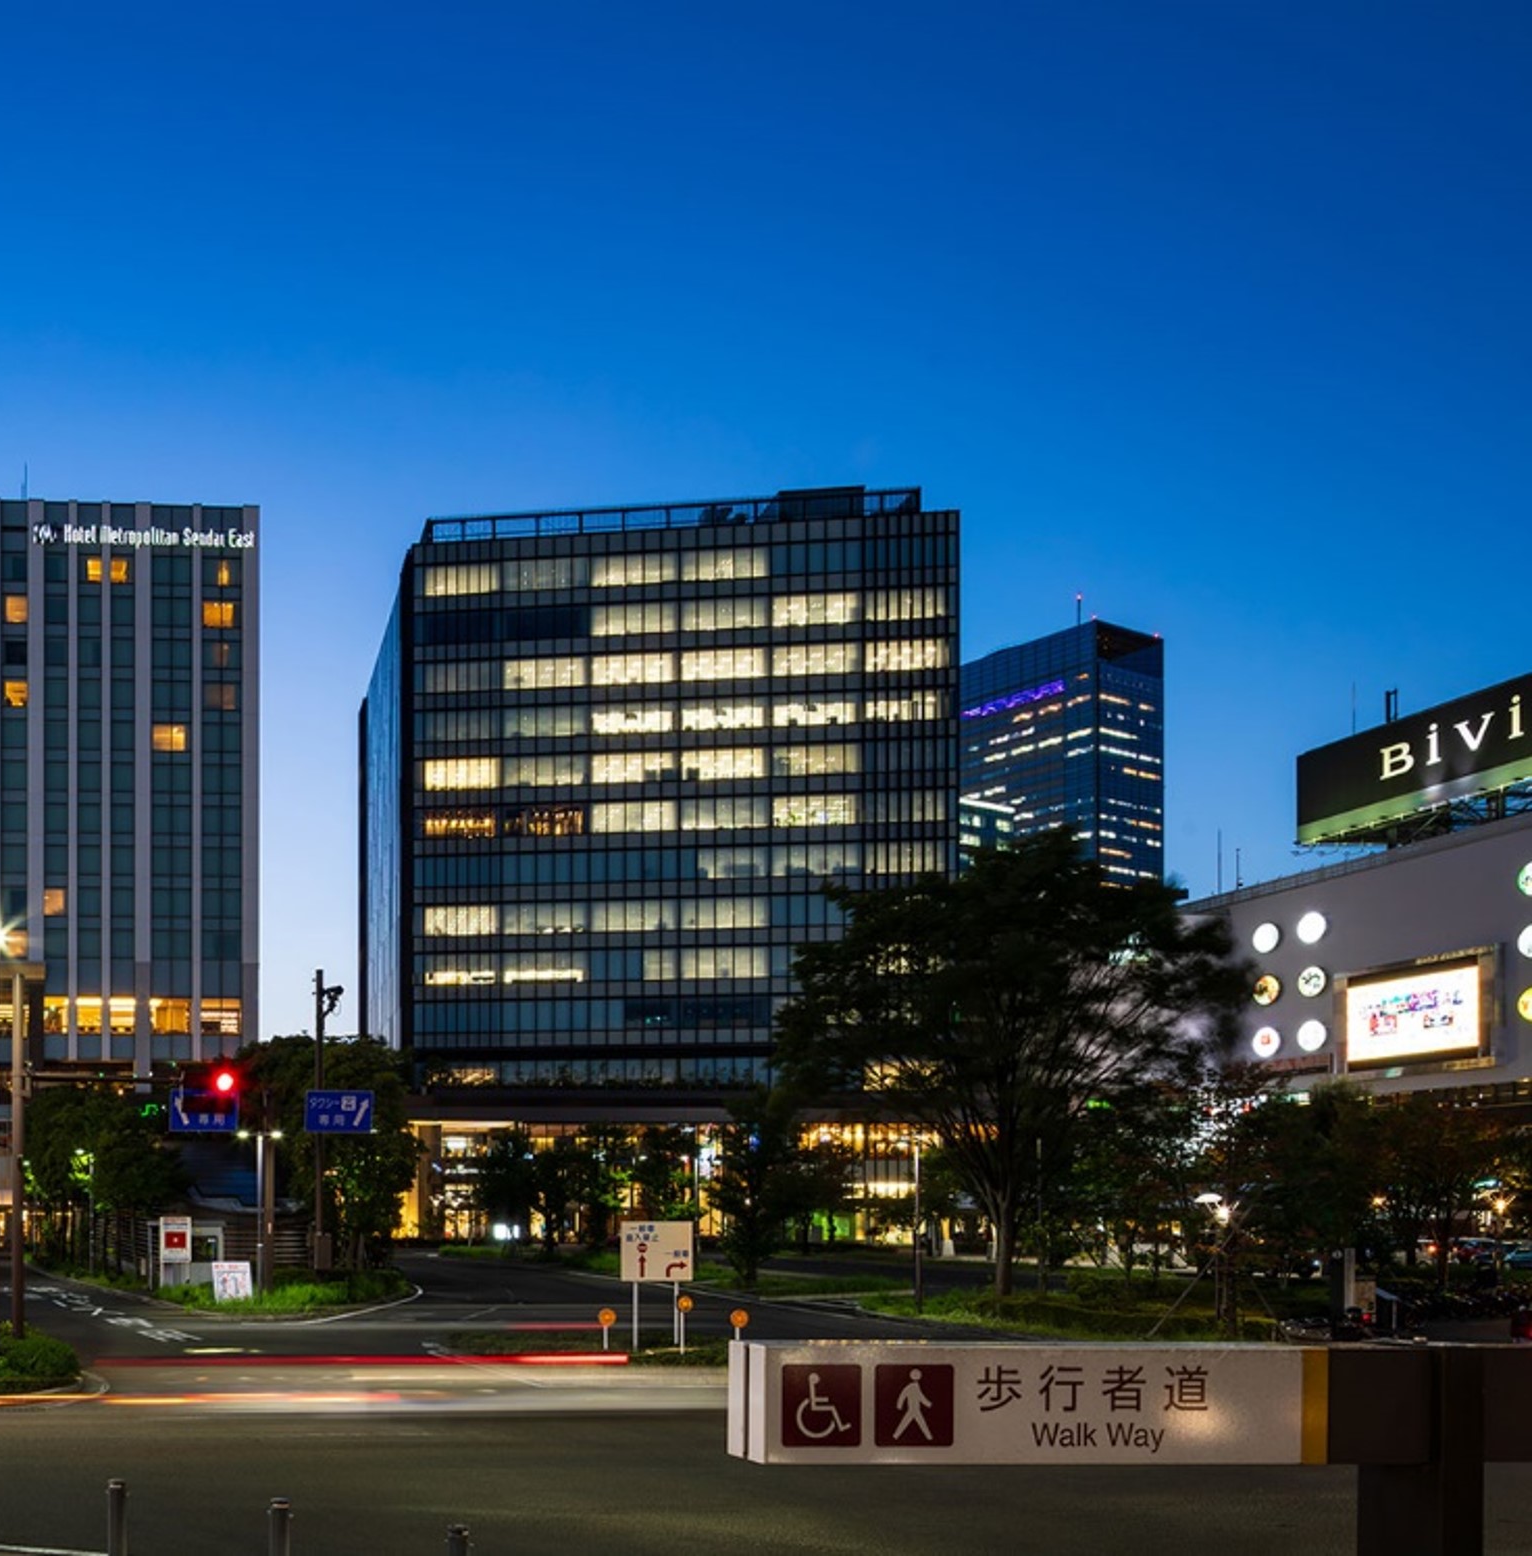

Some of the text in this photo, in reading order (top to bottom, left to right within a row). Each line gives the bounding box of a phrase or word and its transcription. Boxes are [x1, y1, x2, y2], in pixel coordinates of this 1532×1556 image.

[64, 524, 96, 544] Hotel
[99, 526, 180, 549] Metropolitan
[228, 528, 255, 549] East
[976, 1364, 1210, 1413] 歩行者道
[1031, 1422, 1166, 1453] Walk Way
